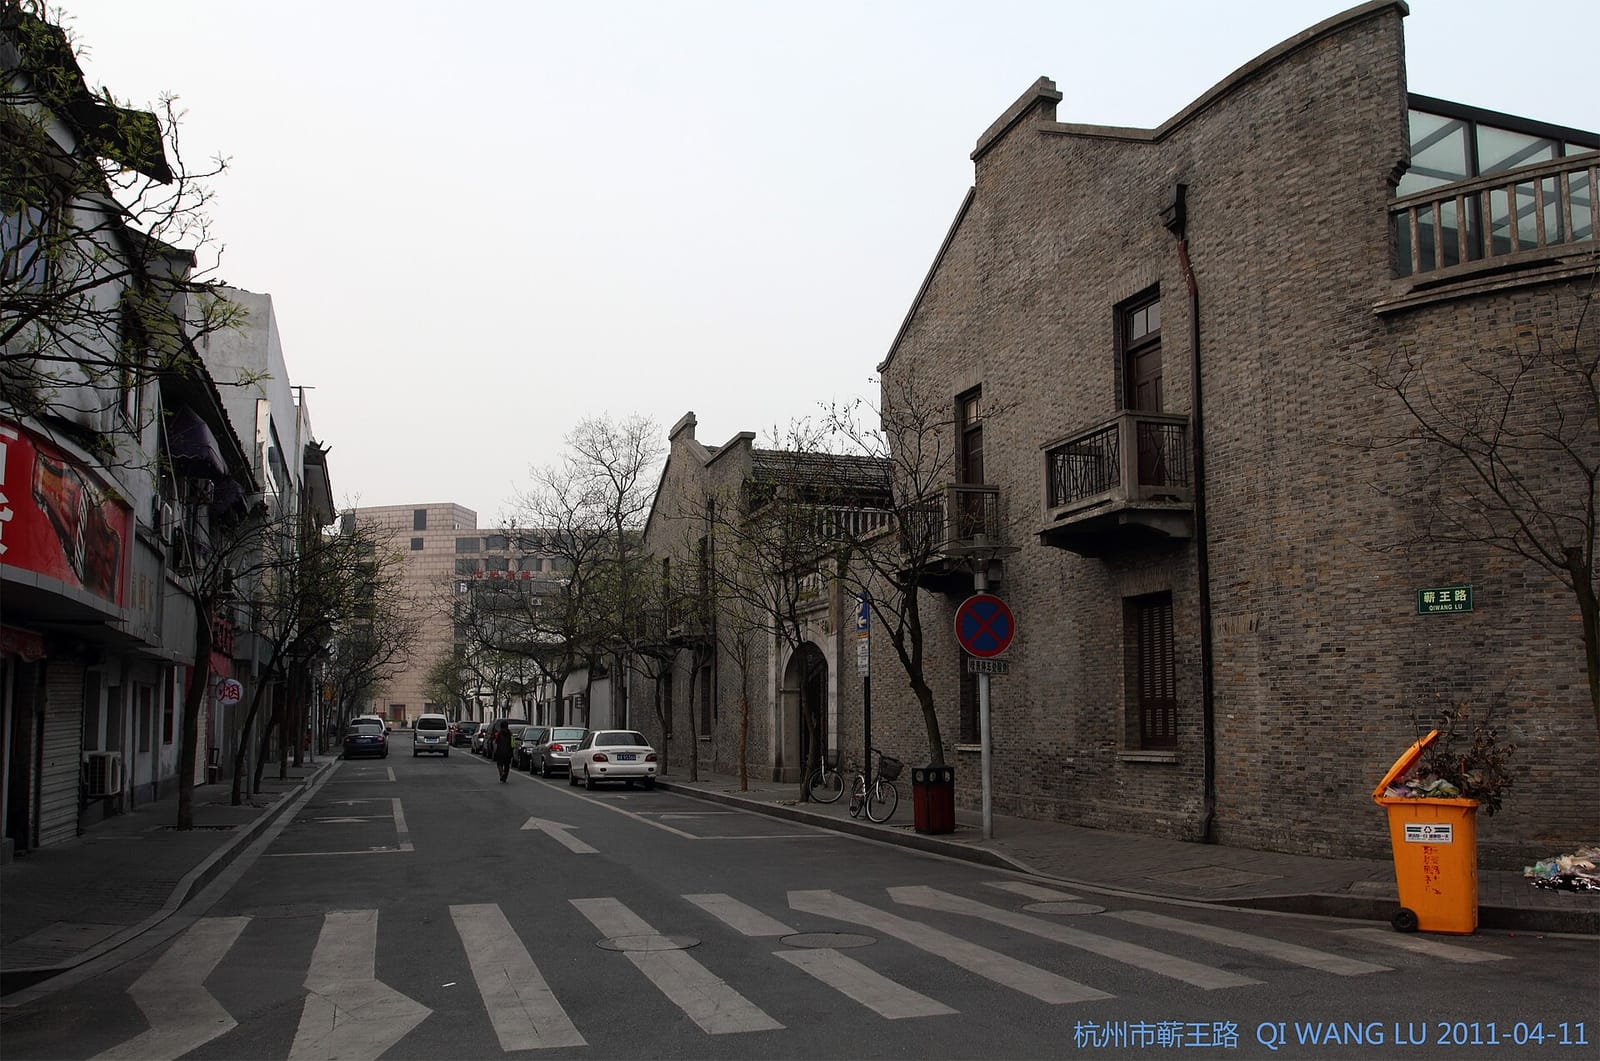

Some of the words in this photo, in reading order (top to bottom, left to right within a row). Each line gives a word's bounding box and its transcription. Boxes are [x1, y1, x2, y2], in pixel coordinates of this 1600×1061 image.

[1423, 589, 1467, 604] 蕲王路
[1428, 604, 1453, 612] QIWANG
[219, 682, 241, 702] 烟
